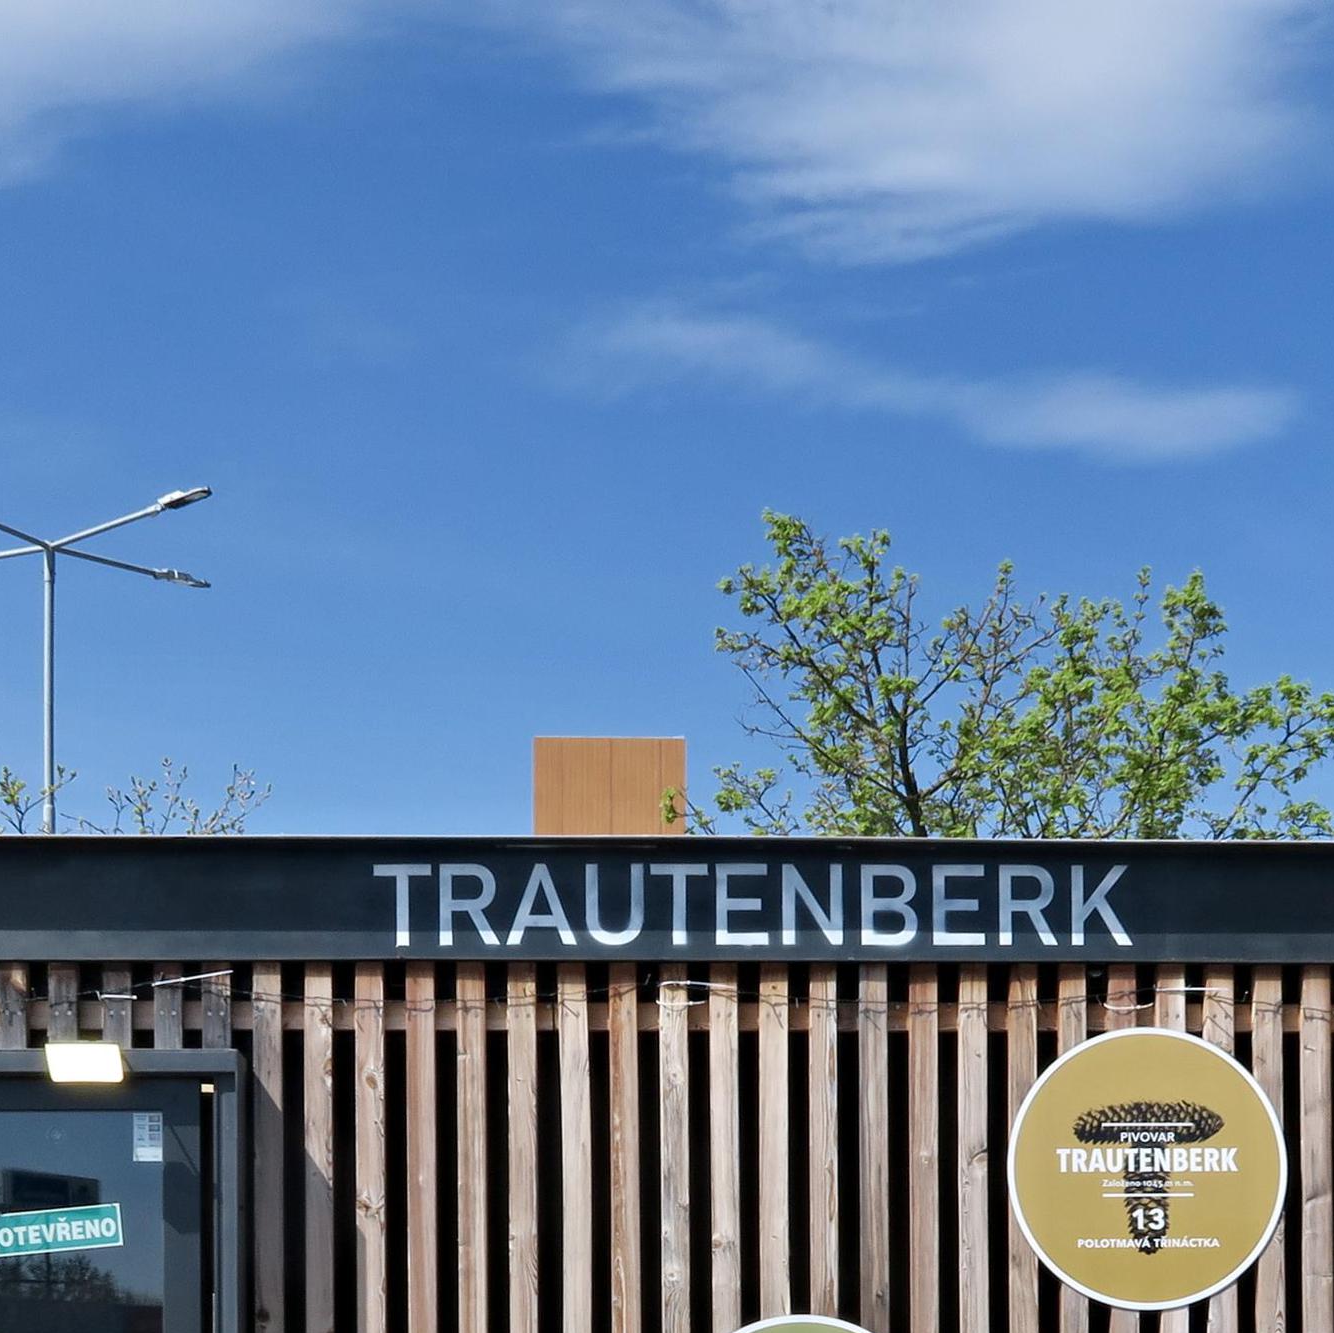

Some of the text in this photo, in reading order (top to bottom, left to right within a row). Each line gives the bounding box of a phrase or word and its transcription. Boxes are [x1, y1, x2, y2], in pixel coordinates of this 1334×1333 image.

[372, 863, 1134, 947] TRAUTENBERK
[1120, 1131, 1176, 1143] PIVOVAR
[1056, 1147, 1239, 1173] TRAUTENBERK
[1132, 1208, 1166, 1231] 13
[1077, 1235, 1220, 1249] POLOTMAVÁ TŘINÁCTKA
